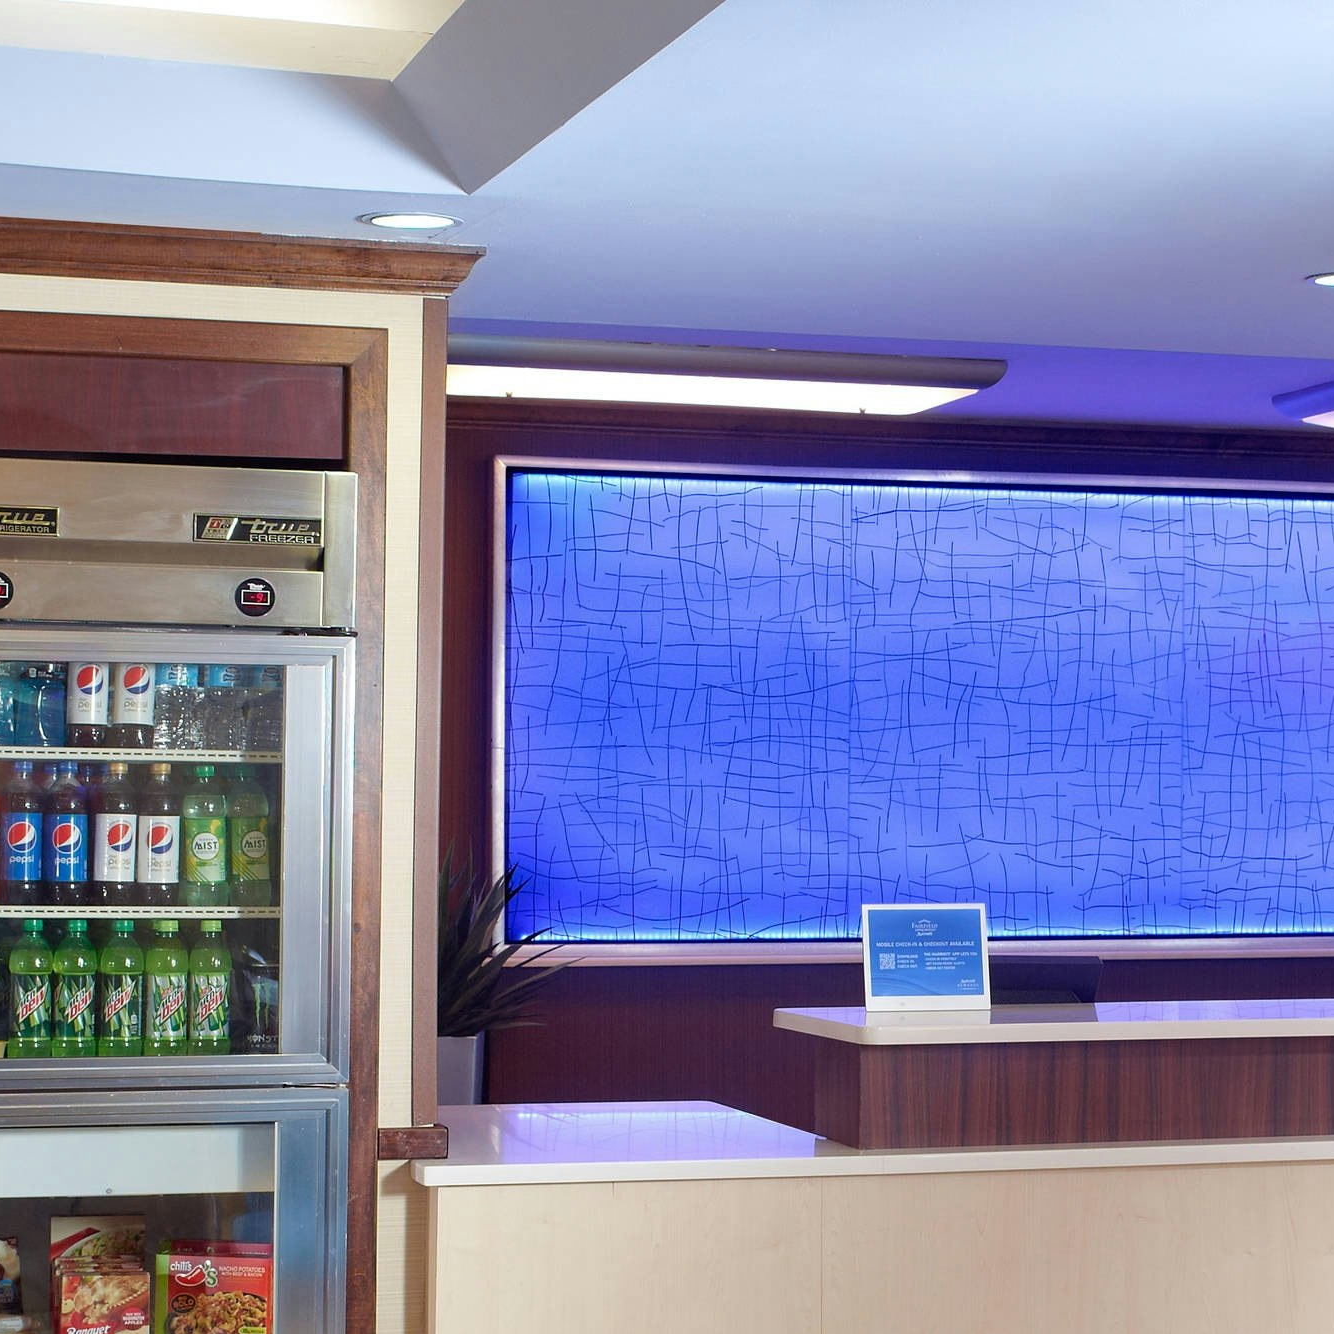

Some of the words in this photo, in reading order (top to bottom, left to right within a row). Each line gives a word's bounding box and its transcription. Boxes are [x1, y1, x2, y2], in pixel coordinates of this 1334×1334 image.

[250, 534, 315, 544] FREEZER
[194, 841, 218, 850] MIST
[244, 840, 267, 850] MIST
[10, 855, 34, 864] pepsi
[55, 856, 79, 865] pepsi
